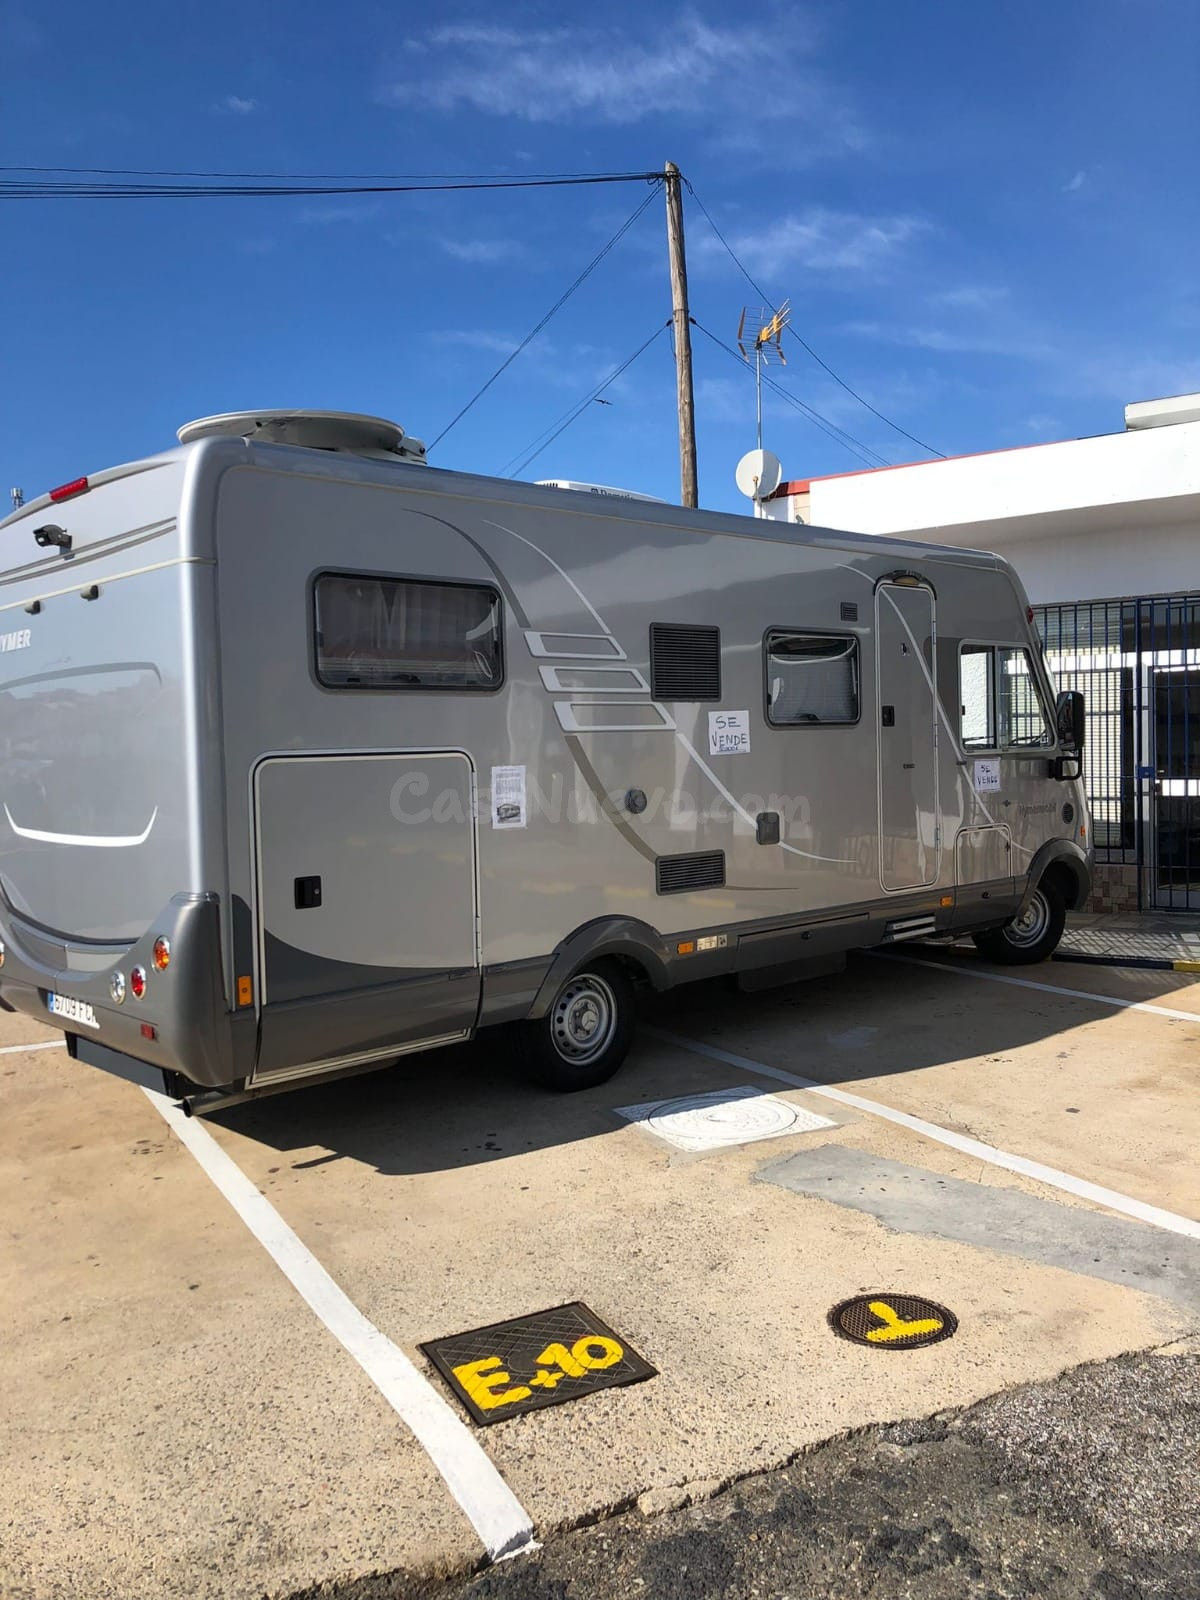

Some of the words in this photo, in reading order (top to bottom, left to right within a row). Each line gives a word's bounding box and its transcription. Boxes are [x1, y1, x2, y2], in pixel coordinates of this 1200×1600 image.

[0, 629, 31, 652] YMER
[716, 716, 741, 729] SE
[712, 731, 748, 747] VENDE
